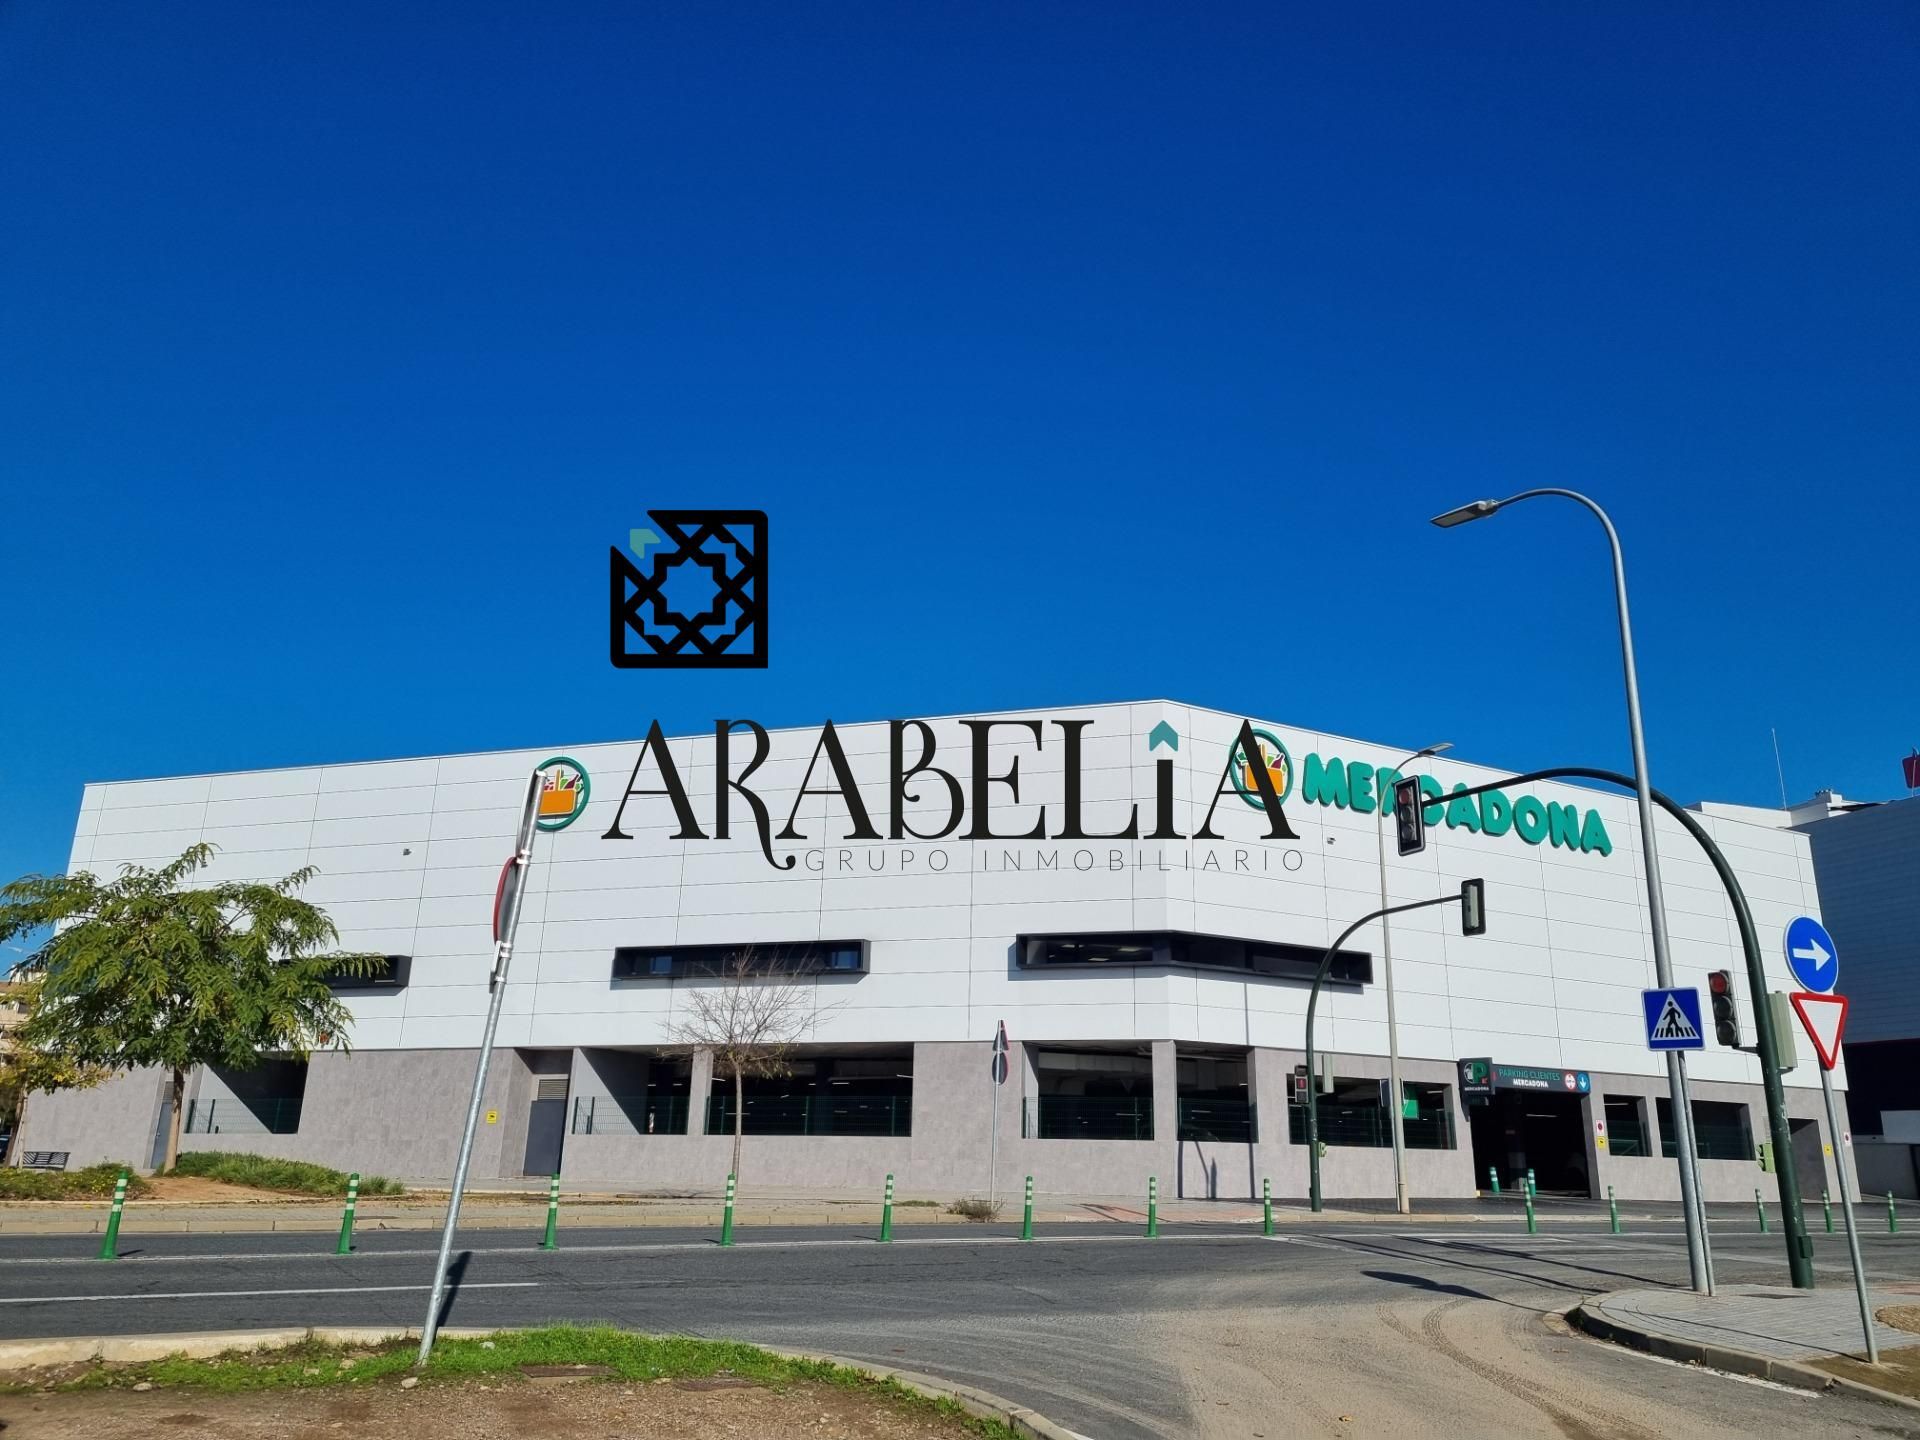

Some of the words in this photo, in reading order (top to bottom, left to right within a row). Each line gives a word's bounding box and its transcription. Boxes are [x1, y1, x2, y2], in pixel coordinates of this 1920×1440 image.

[1302, 752, 1613, 857] MERCADONA
[1498, 1067, 1529, 1079] PARKING
[1530, 1070, 1561, 1081] CLIENTES
[1513, 1078, 1549, 1088] MERCADONA
